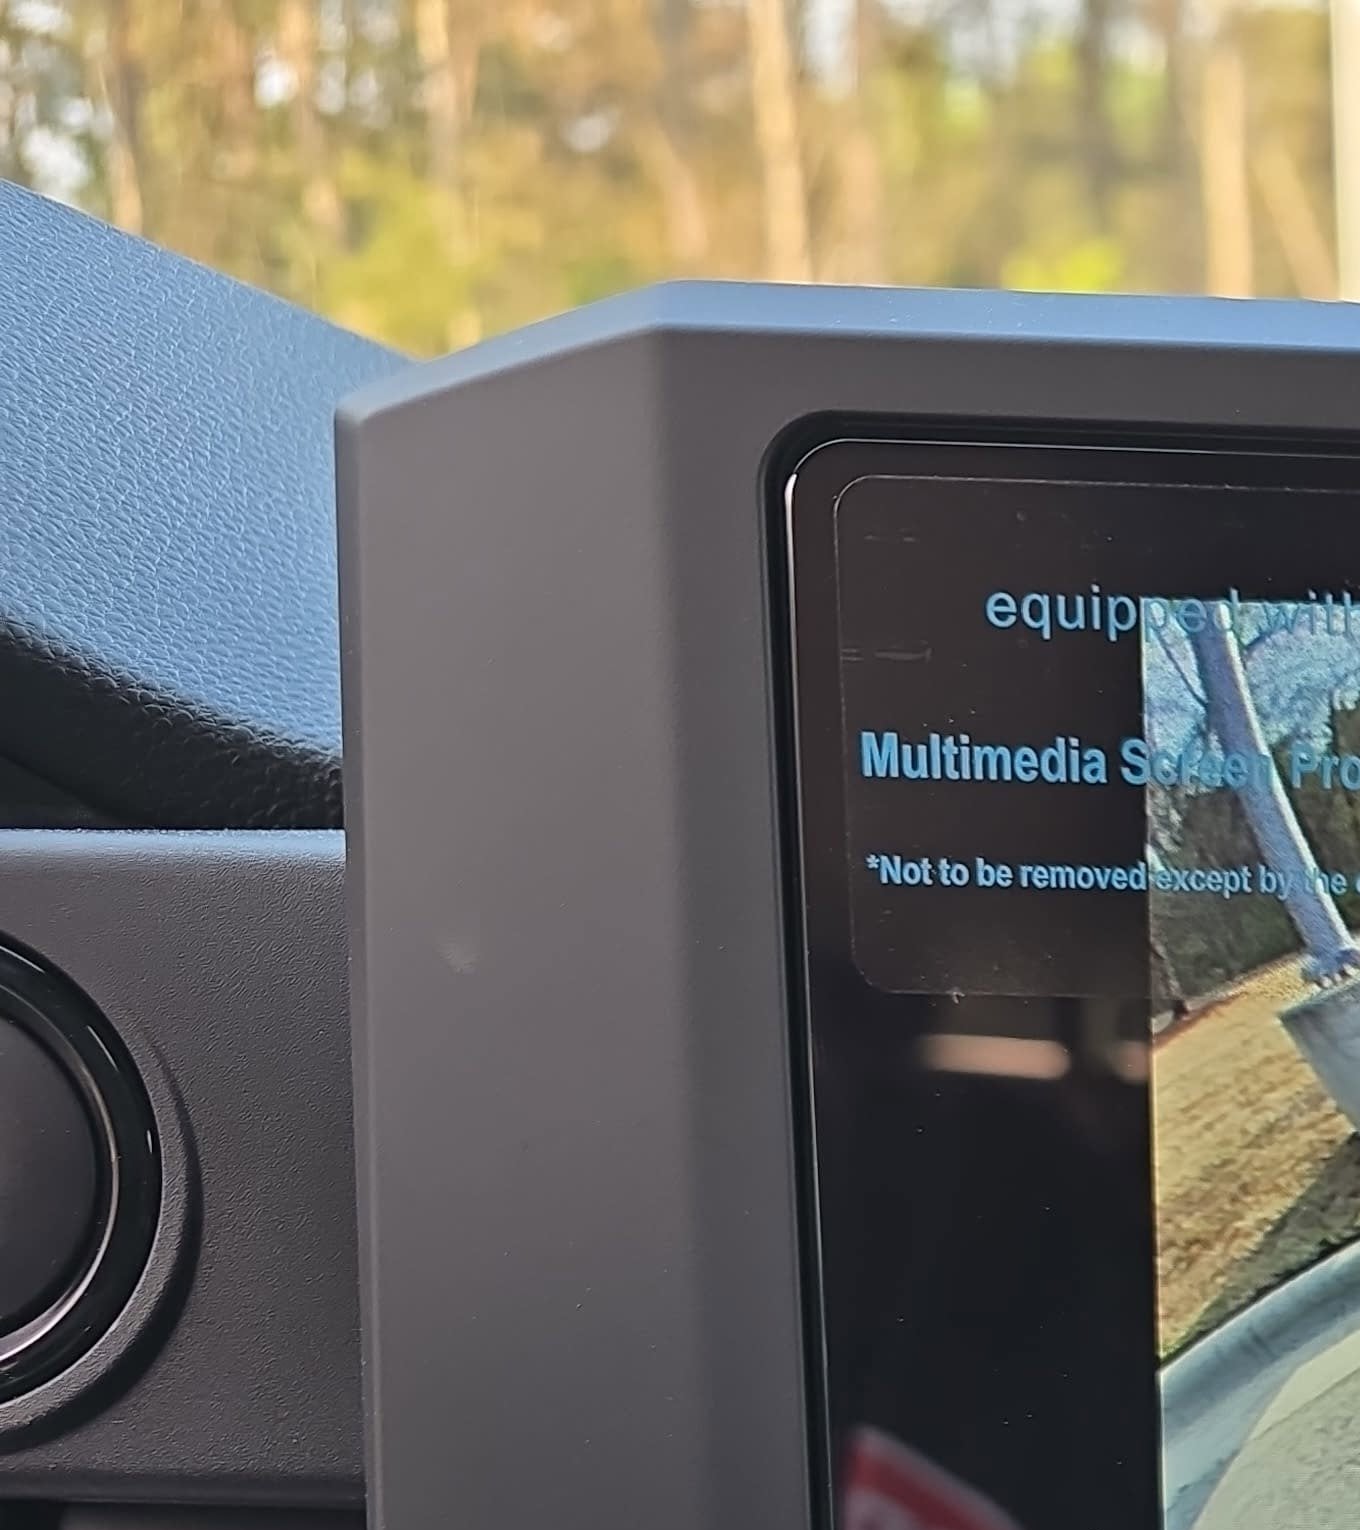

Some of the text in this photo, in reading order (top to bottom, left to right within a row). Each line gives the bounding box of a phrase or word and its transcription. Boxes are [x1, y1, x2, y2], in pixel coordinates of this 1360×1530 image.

[985, 583, 1239, 642] equipped
[860, 730, 1108, 786] Multimedia
[1119, 737, 1272, 788] Screen
[939, 858, 969, 888] to
[976, 857, 1013, 891] be
[1019, 860, 1148, 893] removed
[1155, 865, 1253, 900] except
[1258, 864, 1297, 901] by
